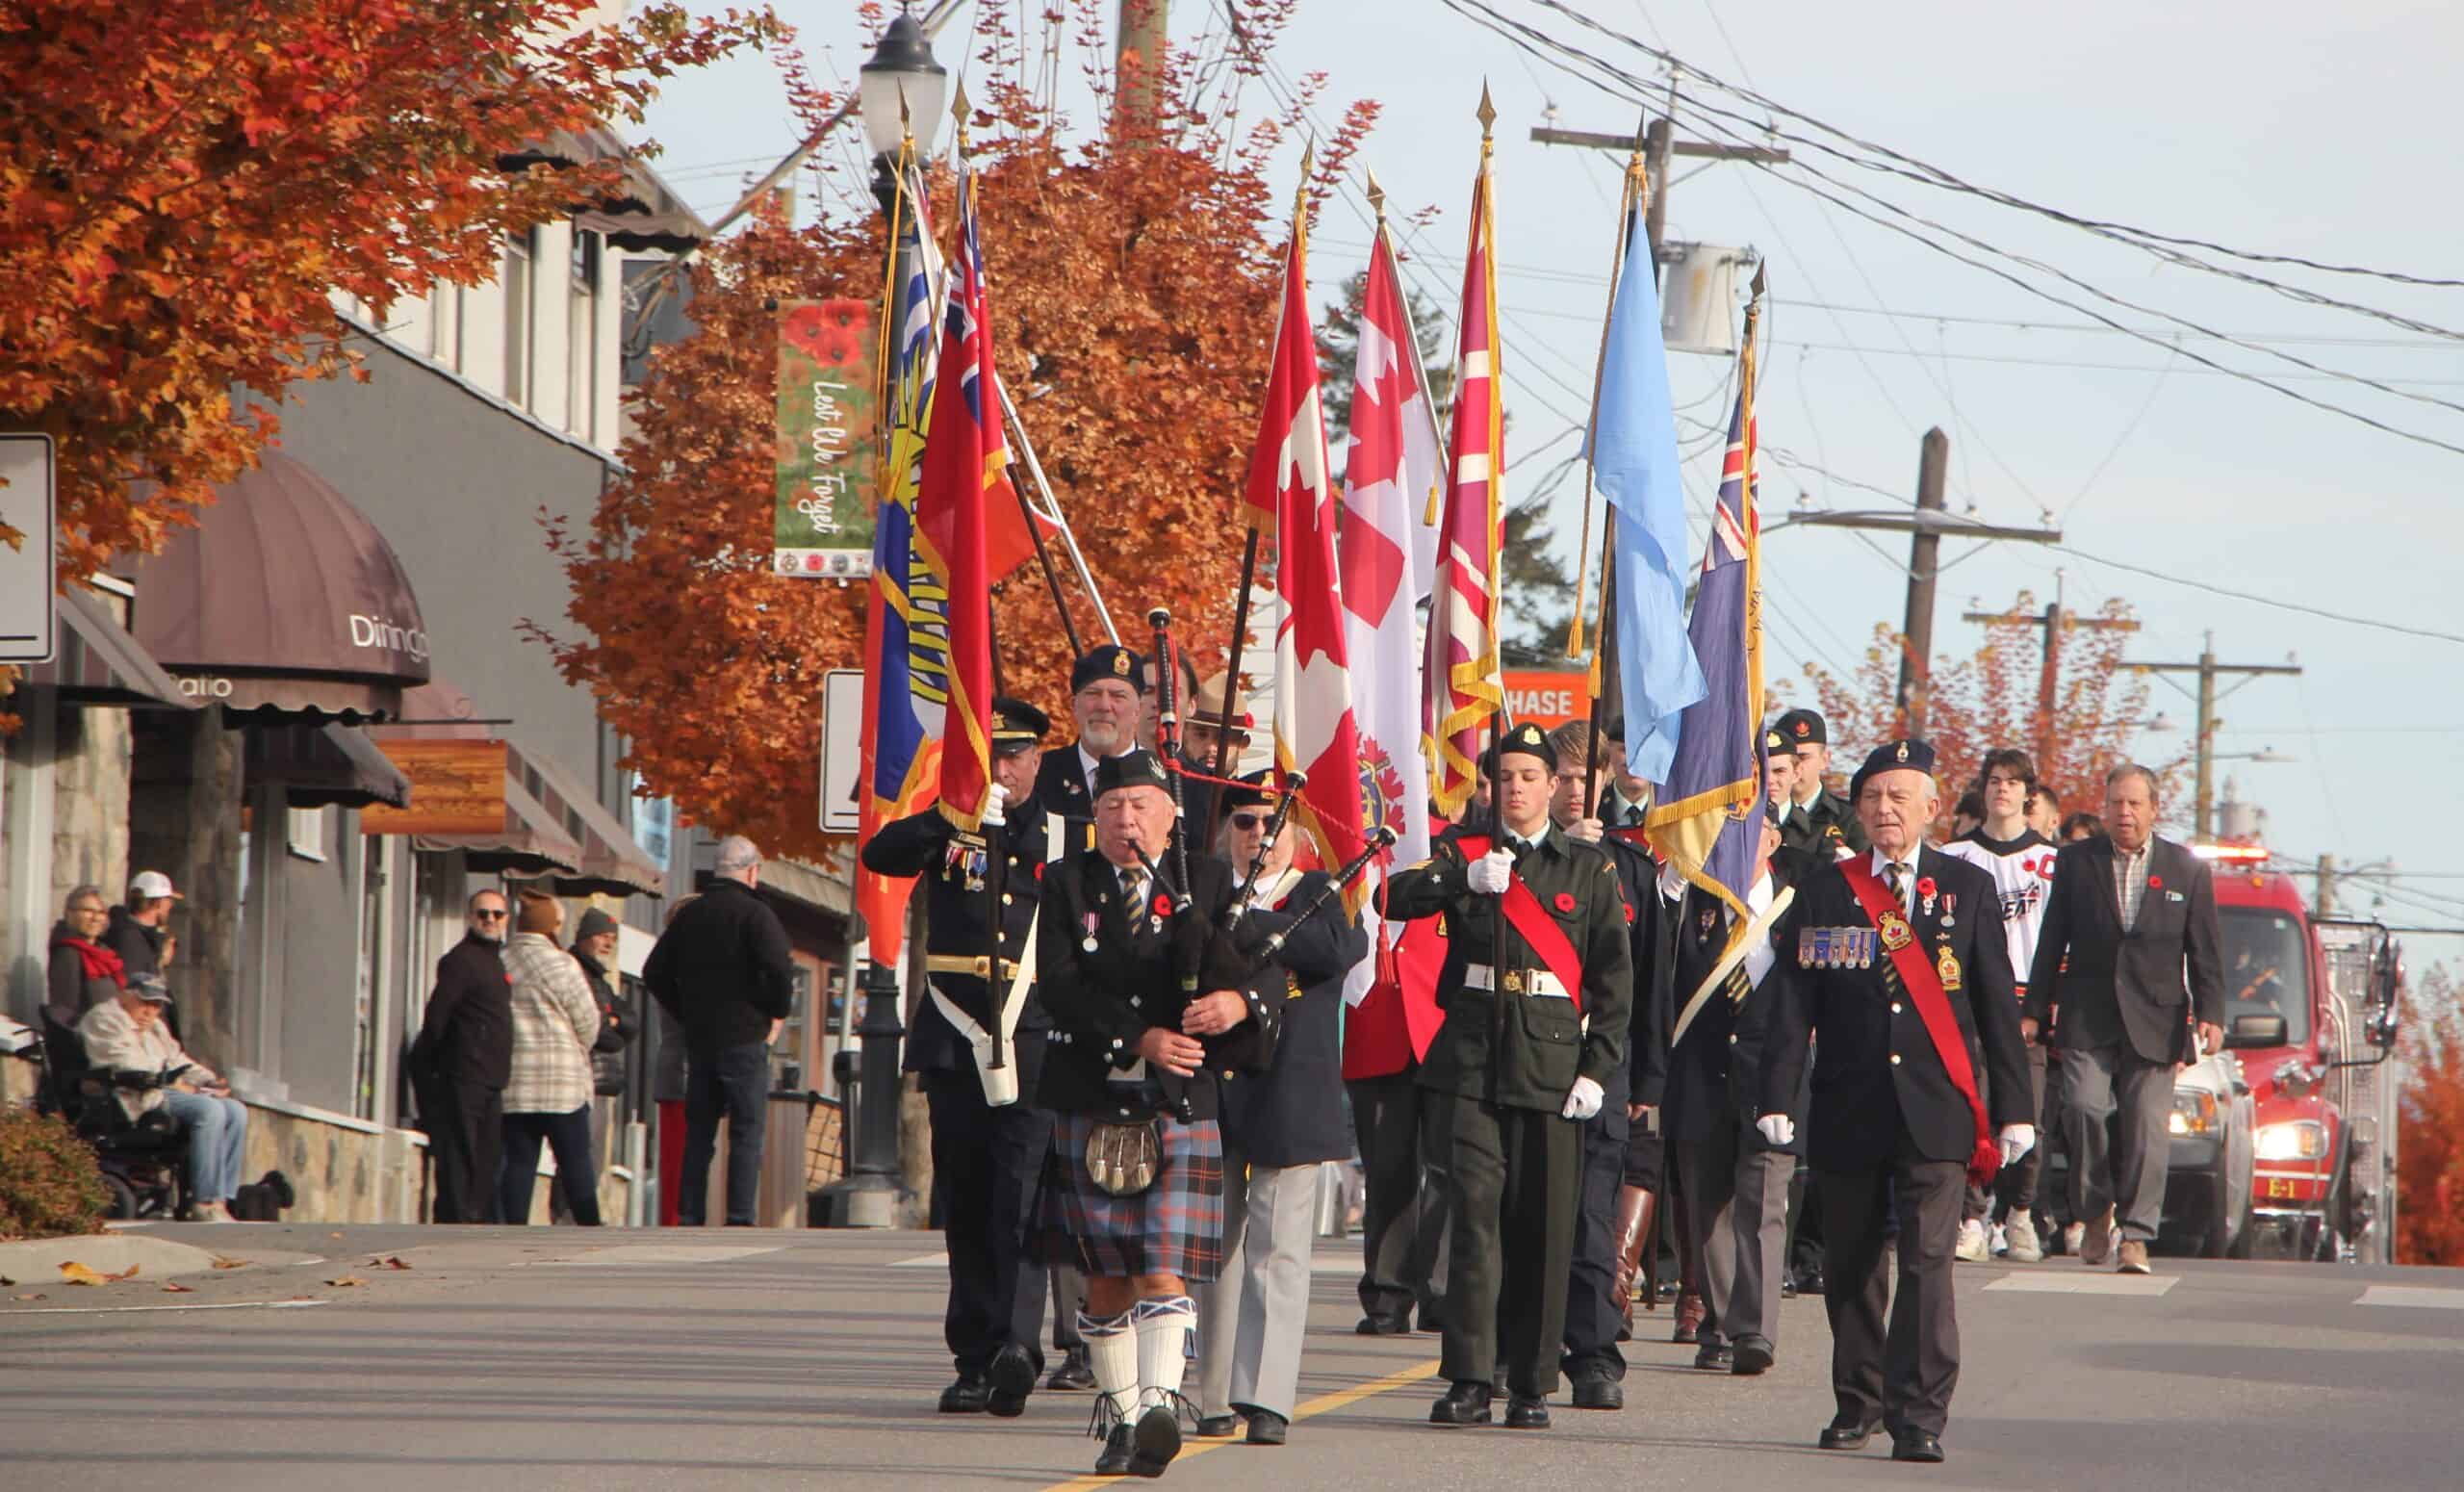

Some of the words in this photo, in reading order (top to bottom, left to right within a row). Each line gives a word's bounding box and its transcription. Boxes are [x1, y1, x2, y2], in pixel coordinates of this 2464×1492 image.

[813, 381, 847, 422] Lest
[811, 427, 847, 464] We
[797, 473, 846, 534] Forget
[177, 673, 233, 697] atio
[1506, 690, 1572, 715] HASE
[2002, 899, 2038, 921] EAT
